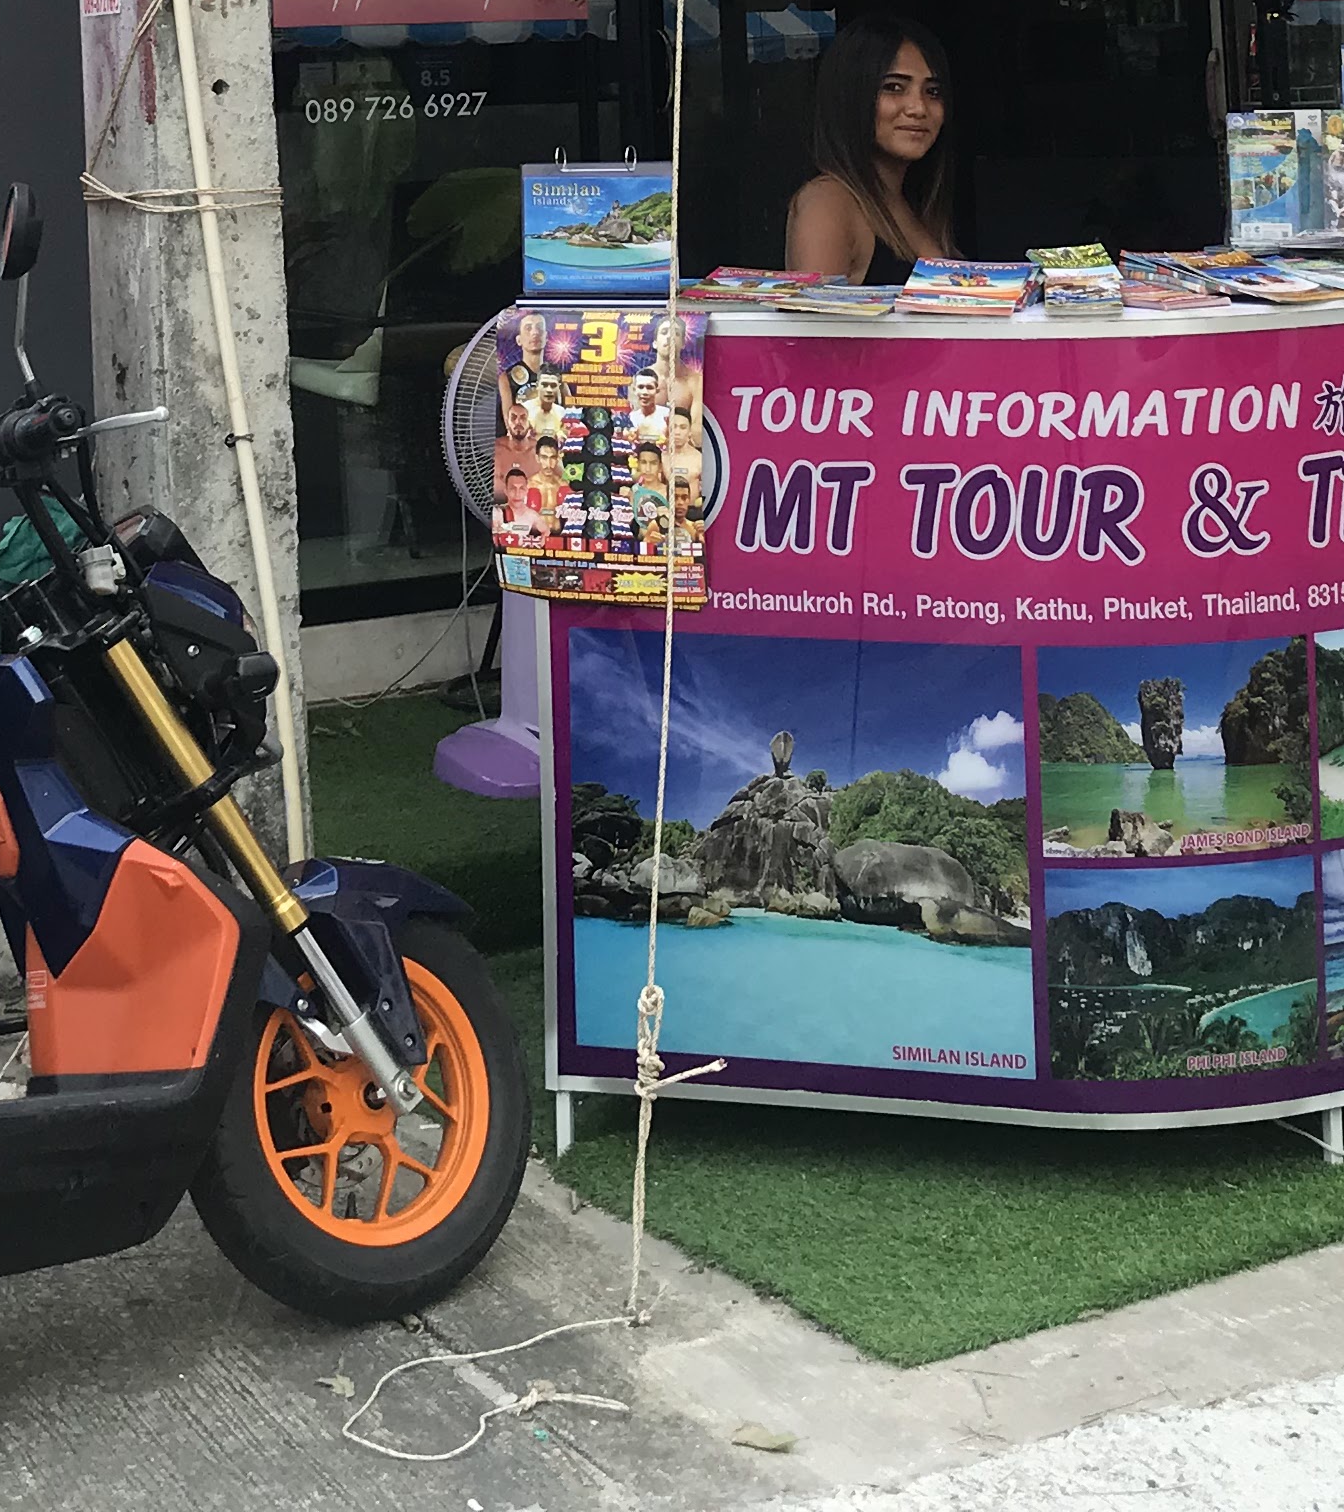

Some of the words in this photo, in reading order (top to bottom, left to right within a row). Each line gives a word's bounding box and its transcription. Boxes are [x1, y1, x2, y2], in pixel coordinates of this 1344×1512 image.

[305, 97, 355, 124] 089
[364, 94, 414, 121] 726
[423, 91, 488, 118] 6927
[531, 182, 601, 197] Similan
[580, 321, 619, 363] 3
[730, 386, 874, 438] TOUR
[900, 381, 1302, 441] INFORMATION
[734, 458, 876, 557] MT
[899, 461, 1146, 567] TOUR
[1181, 462, 1271, 559] &
[863, 592, 907, 620] Rd.,
[916, 593, 1006, 625] Patong,
[1016, 597, 1093, 623] Kathu,
[1103, 595, 1193, 622] Phuket,
[1202, 587, 1300, 619] Thailand,
[1179, 832, 1224, 850] JAMES
[1226, 828, 1264, 846] BOND
[1265, 823, 1312, 841] ISLAND
[892, 1045, 961, 1065] SIMILAN
[965, 1050, 1027, 1070] ISLAND
[1186, 1055, 1210, 1070] PHI
[1212, 1054, 1236, 1069] PHI
[1240, 1046, 1287, 1065] ISLAND
